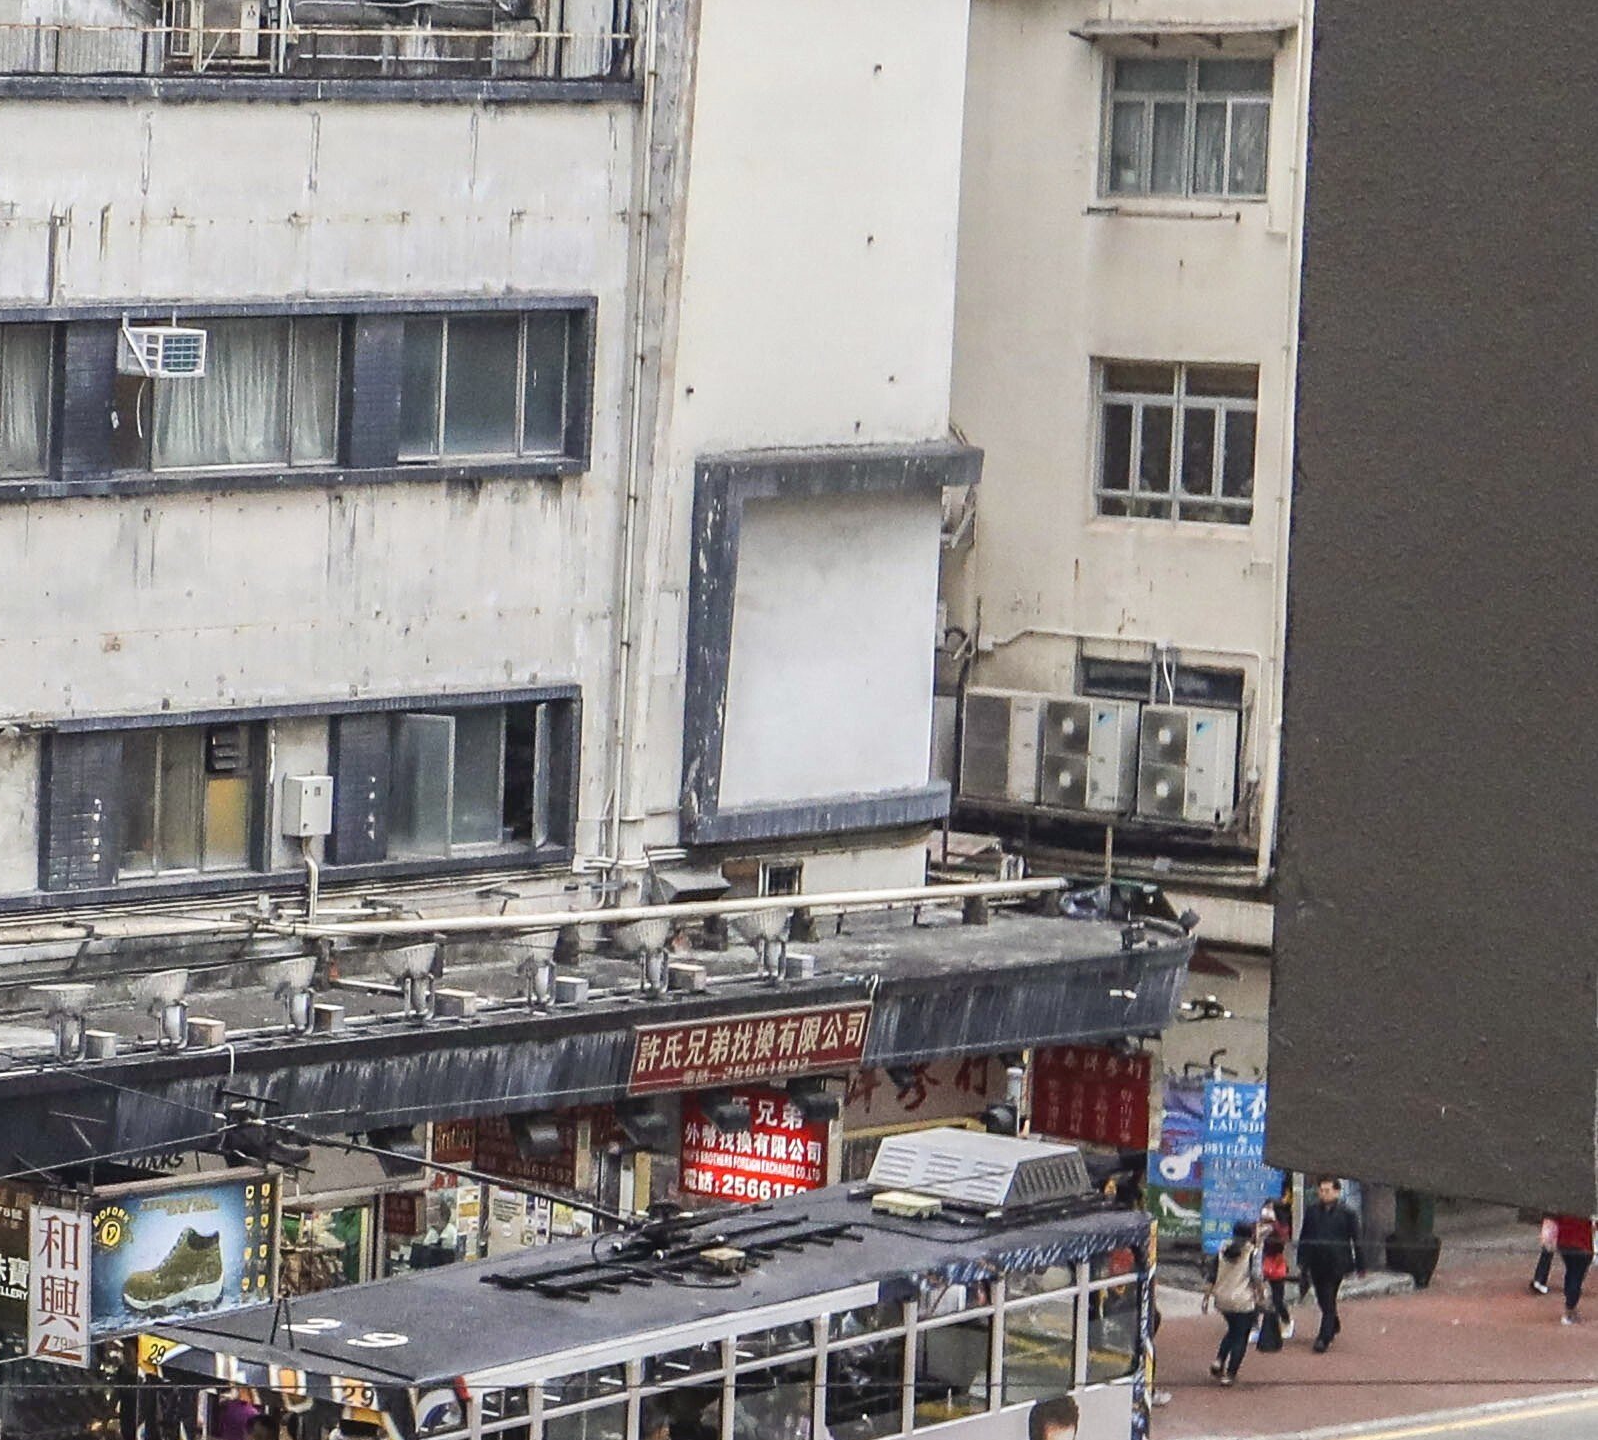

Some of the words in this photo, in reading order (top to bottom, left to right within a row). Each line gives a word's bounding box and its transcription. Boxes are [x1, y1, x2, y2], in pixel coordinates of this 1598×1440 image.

[636, 1011, 867, 1072] 許氏兄弟找換有限公司
[37, 1214, 81, 1332] 和興
[150, 1342, 167, 1365] 29
[343, 1386, 374, 1409] 29
